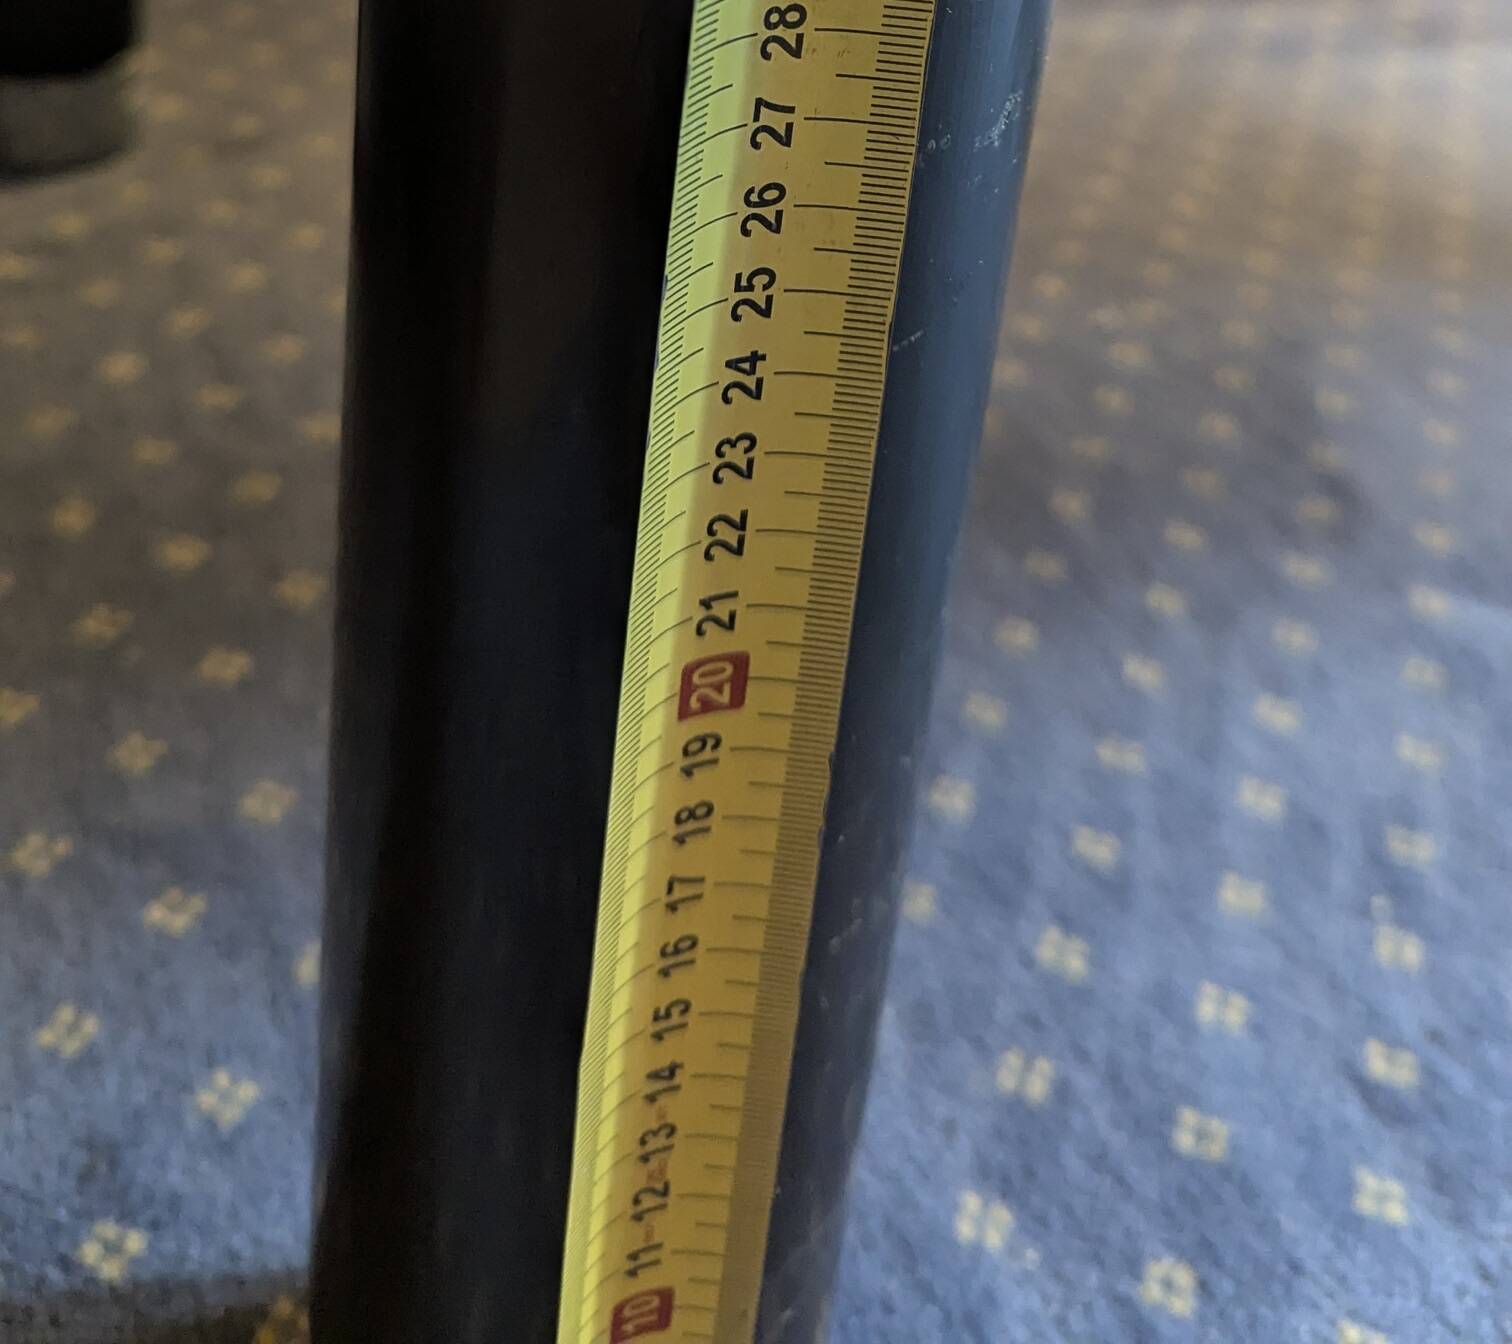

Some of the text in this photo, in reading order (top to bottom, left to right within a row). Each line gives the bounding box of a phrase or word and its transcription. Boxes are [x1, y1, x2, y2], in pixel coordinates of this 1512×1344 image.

[760, 2, 808, 61] 28
[750, 96, 796, 149] 27
[741, 182, 787, 236] 26
[731, 266, 777, 323] 25
[721, 350, 767, 406] 24
[712, 431, 757, 485] 23
[703, 508, 749, 563] 22
[695, 590, 739, 638] 21
[690, 660, 733, 709] 20
[681, 732, 722, 778] 19
[673, 799, 714, 846] 18
[665, 874, 706, 914] 17
[658, 933, 699, 979] 16
[651, 997, 691, 1043] 15
[643, 1060, 684, 1103] 14
[639, 1121, 677, 1164] 13
[630, 1180, 672, 1223] 12
[625, 1240, 664, 1279] 11
[622, 1291, 661, 1336] 10
